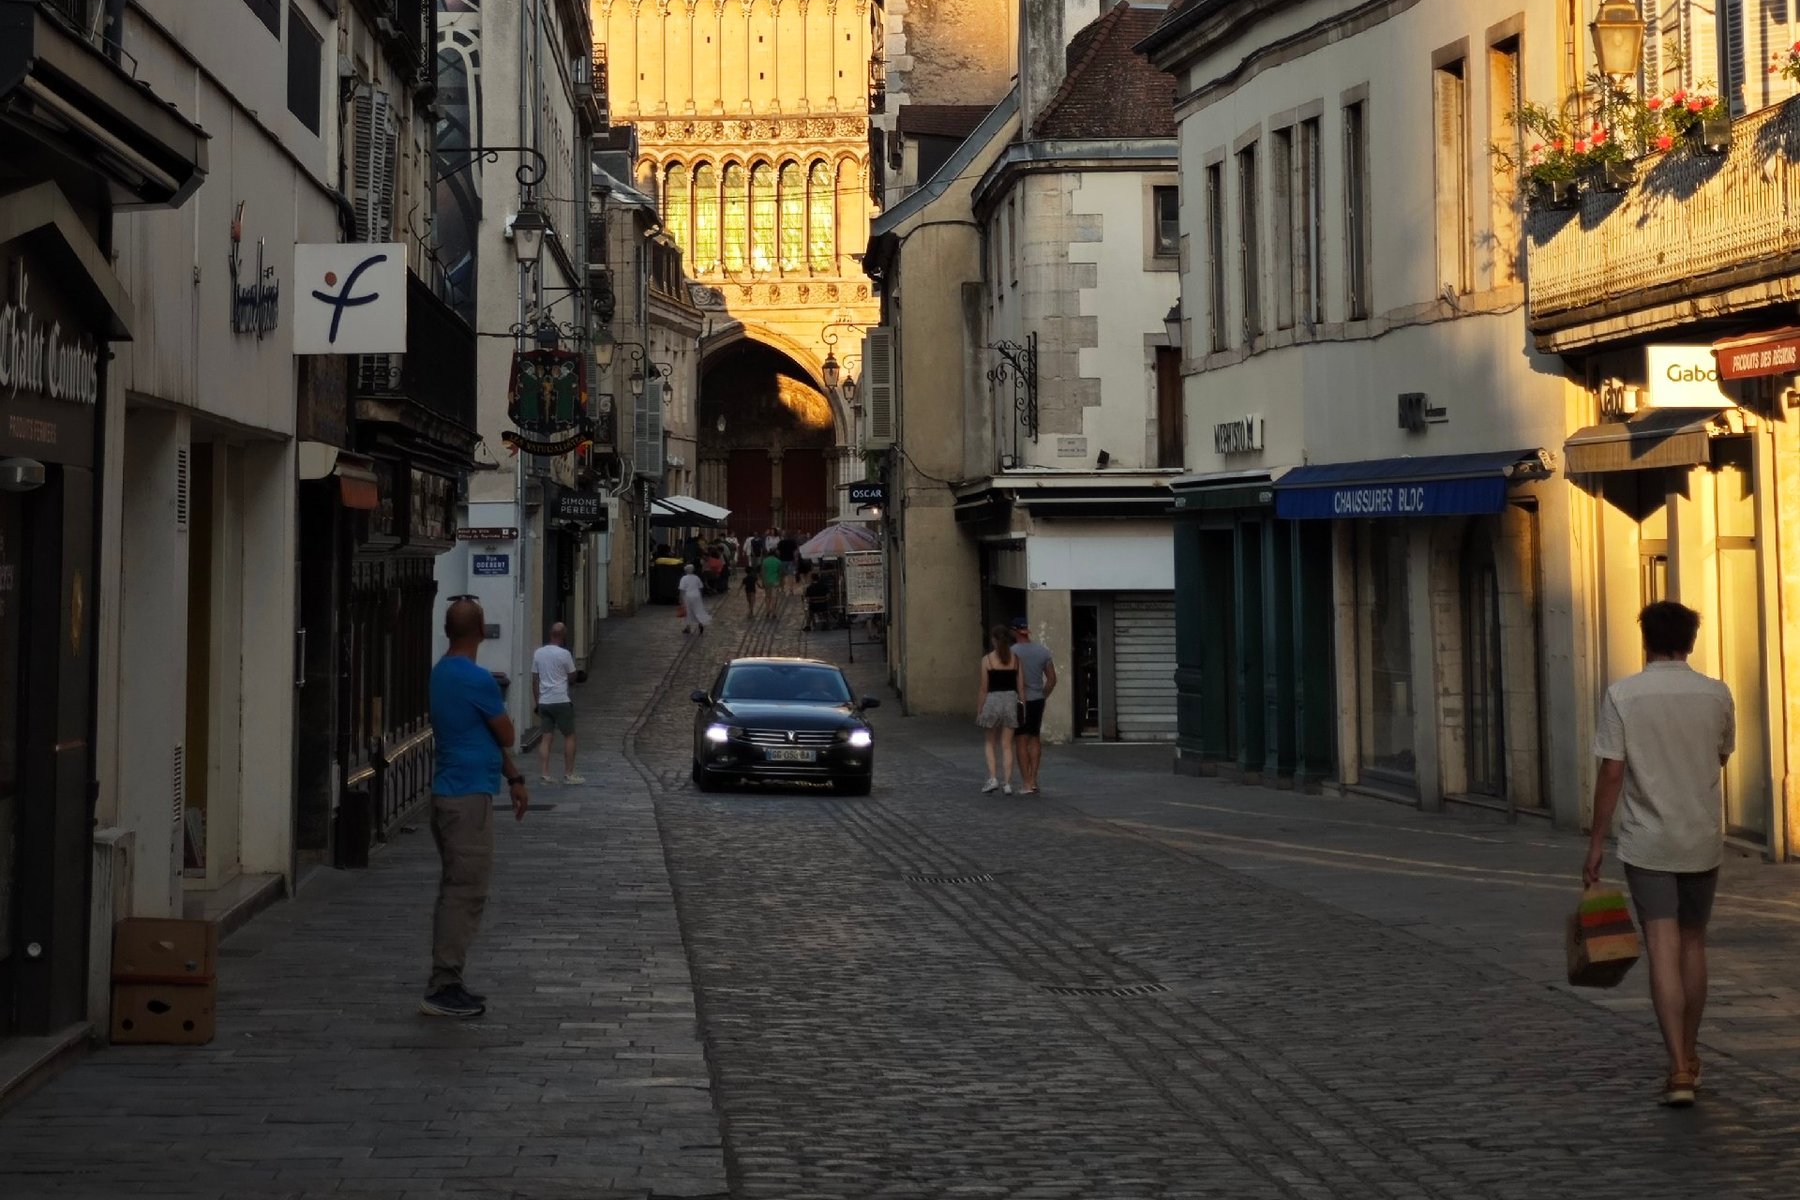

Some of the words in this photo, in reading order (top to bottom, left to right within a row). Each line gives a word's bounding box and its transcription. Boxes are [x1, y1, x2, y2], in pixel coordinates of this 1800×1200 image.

[0, 301, 45, 400] Chalet
[1733, 352, 1760, 373] PRODUITS
[1760, 350, 1772, 369] DES
[1772, 345, 1797, 367] RÉGIONS
[561, 497, 598, 507] SIMONE
[852, 489, 882, 499] OSCAR
[1334, 488, 1393, 514] CHAUSSURES
[1399, 487, 1424, 512] BLOC
